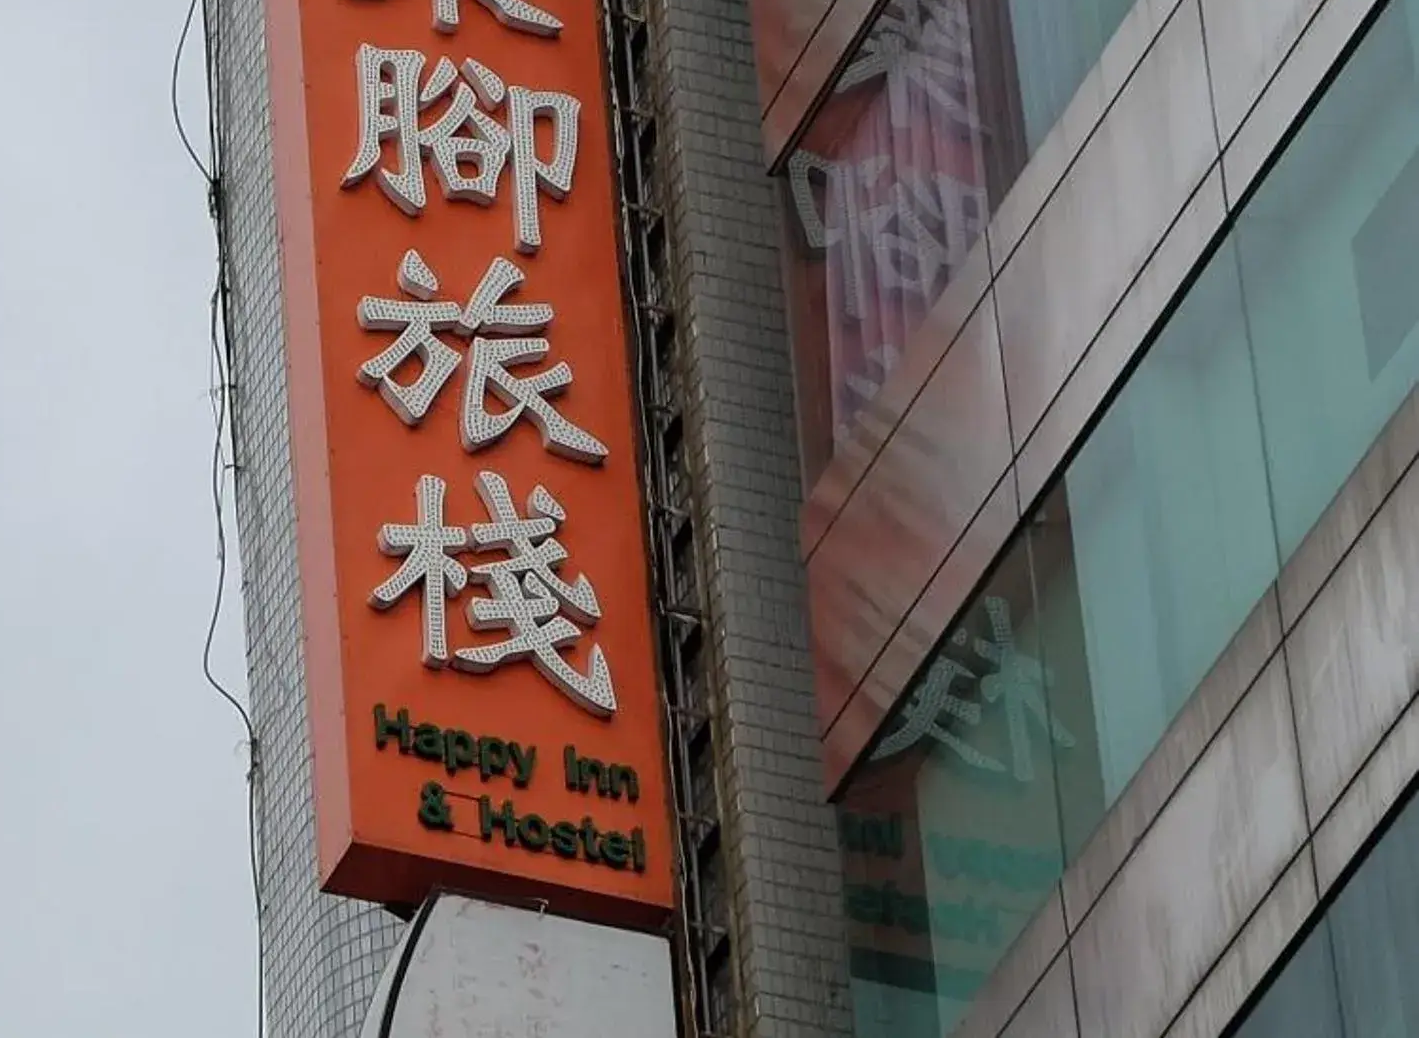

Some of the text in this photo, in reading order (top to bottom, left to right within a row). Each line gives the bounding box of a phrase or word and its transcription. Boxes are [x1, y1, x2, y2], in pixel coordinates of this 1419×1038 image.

[373, 703, 641, 804] Happy Inn
[418, 780, 647, 873] & Hostel
